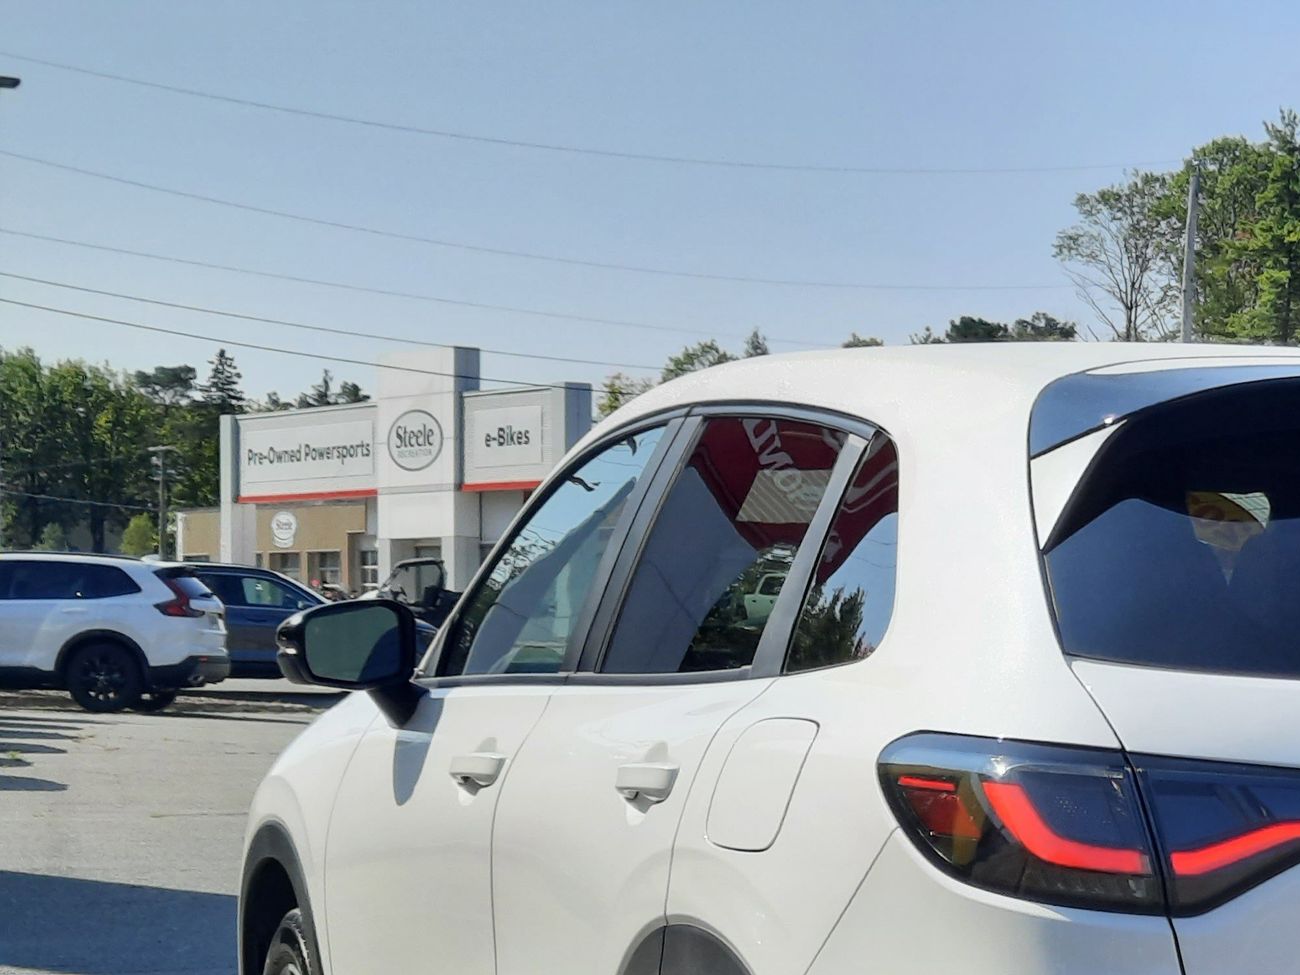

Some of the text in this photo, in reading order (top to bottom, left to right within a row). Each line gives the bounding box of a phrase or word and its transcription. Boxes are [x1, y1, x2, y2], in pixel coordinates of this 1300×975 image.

[395, 423, 434, 449] Steele
[484, 424, 530, 447] e-Bikes
[247, 440, 371, 466] Pre-Owned Powersports
